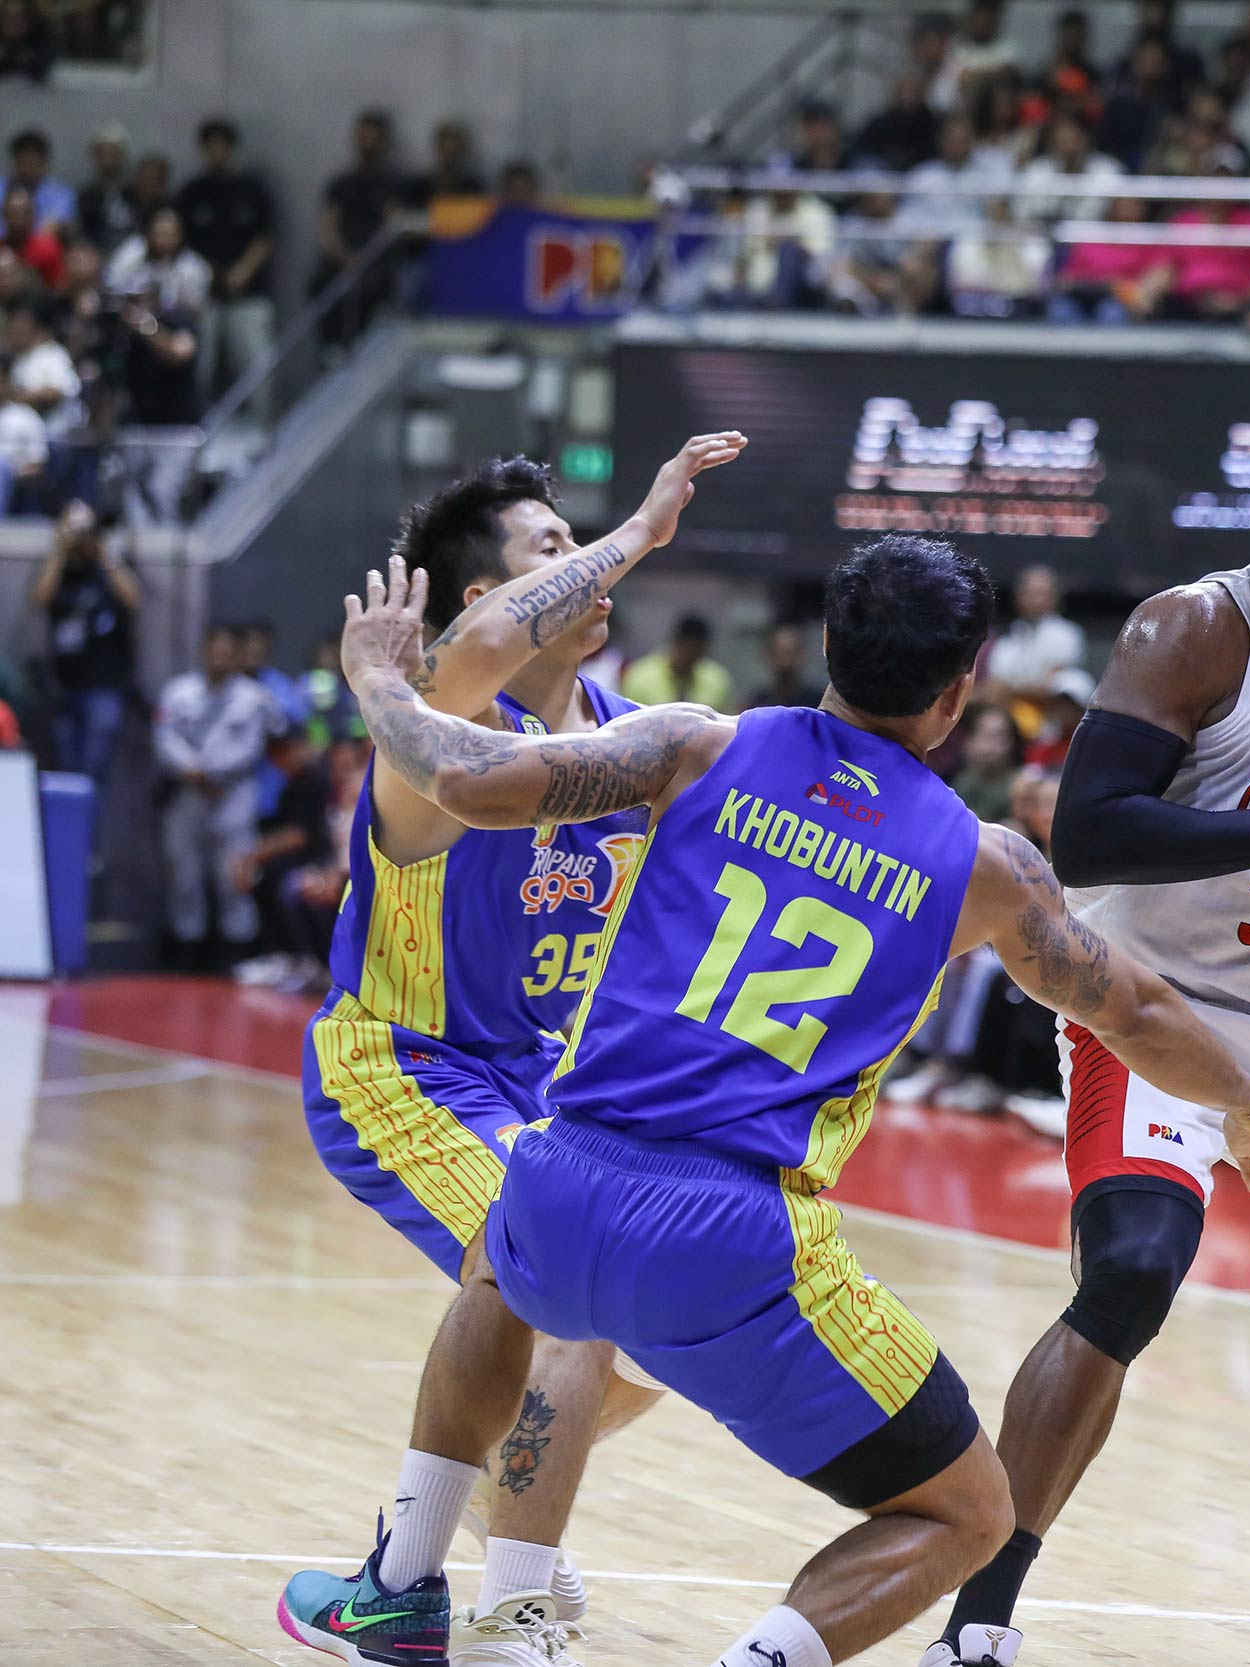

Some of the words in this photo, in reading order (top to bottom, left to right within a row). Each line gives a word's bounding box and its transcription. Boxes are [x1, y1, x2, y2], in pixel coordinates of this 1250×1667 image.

[829, 770, 862, 791] ANTA
[828, 794, 887, 828] PLDT
[713, 788, 932, 922] KHOBUNTIN
[521, 933, 602, 997] 35
[674, 861, 874, 1075] 12
[1148, 1123, 1184, 1146] PBA
